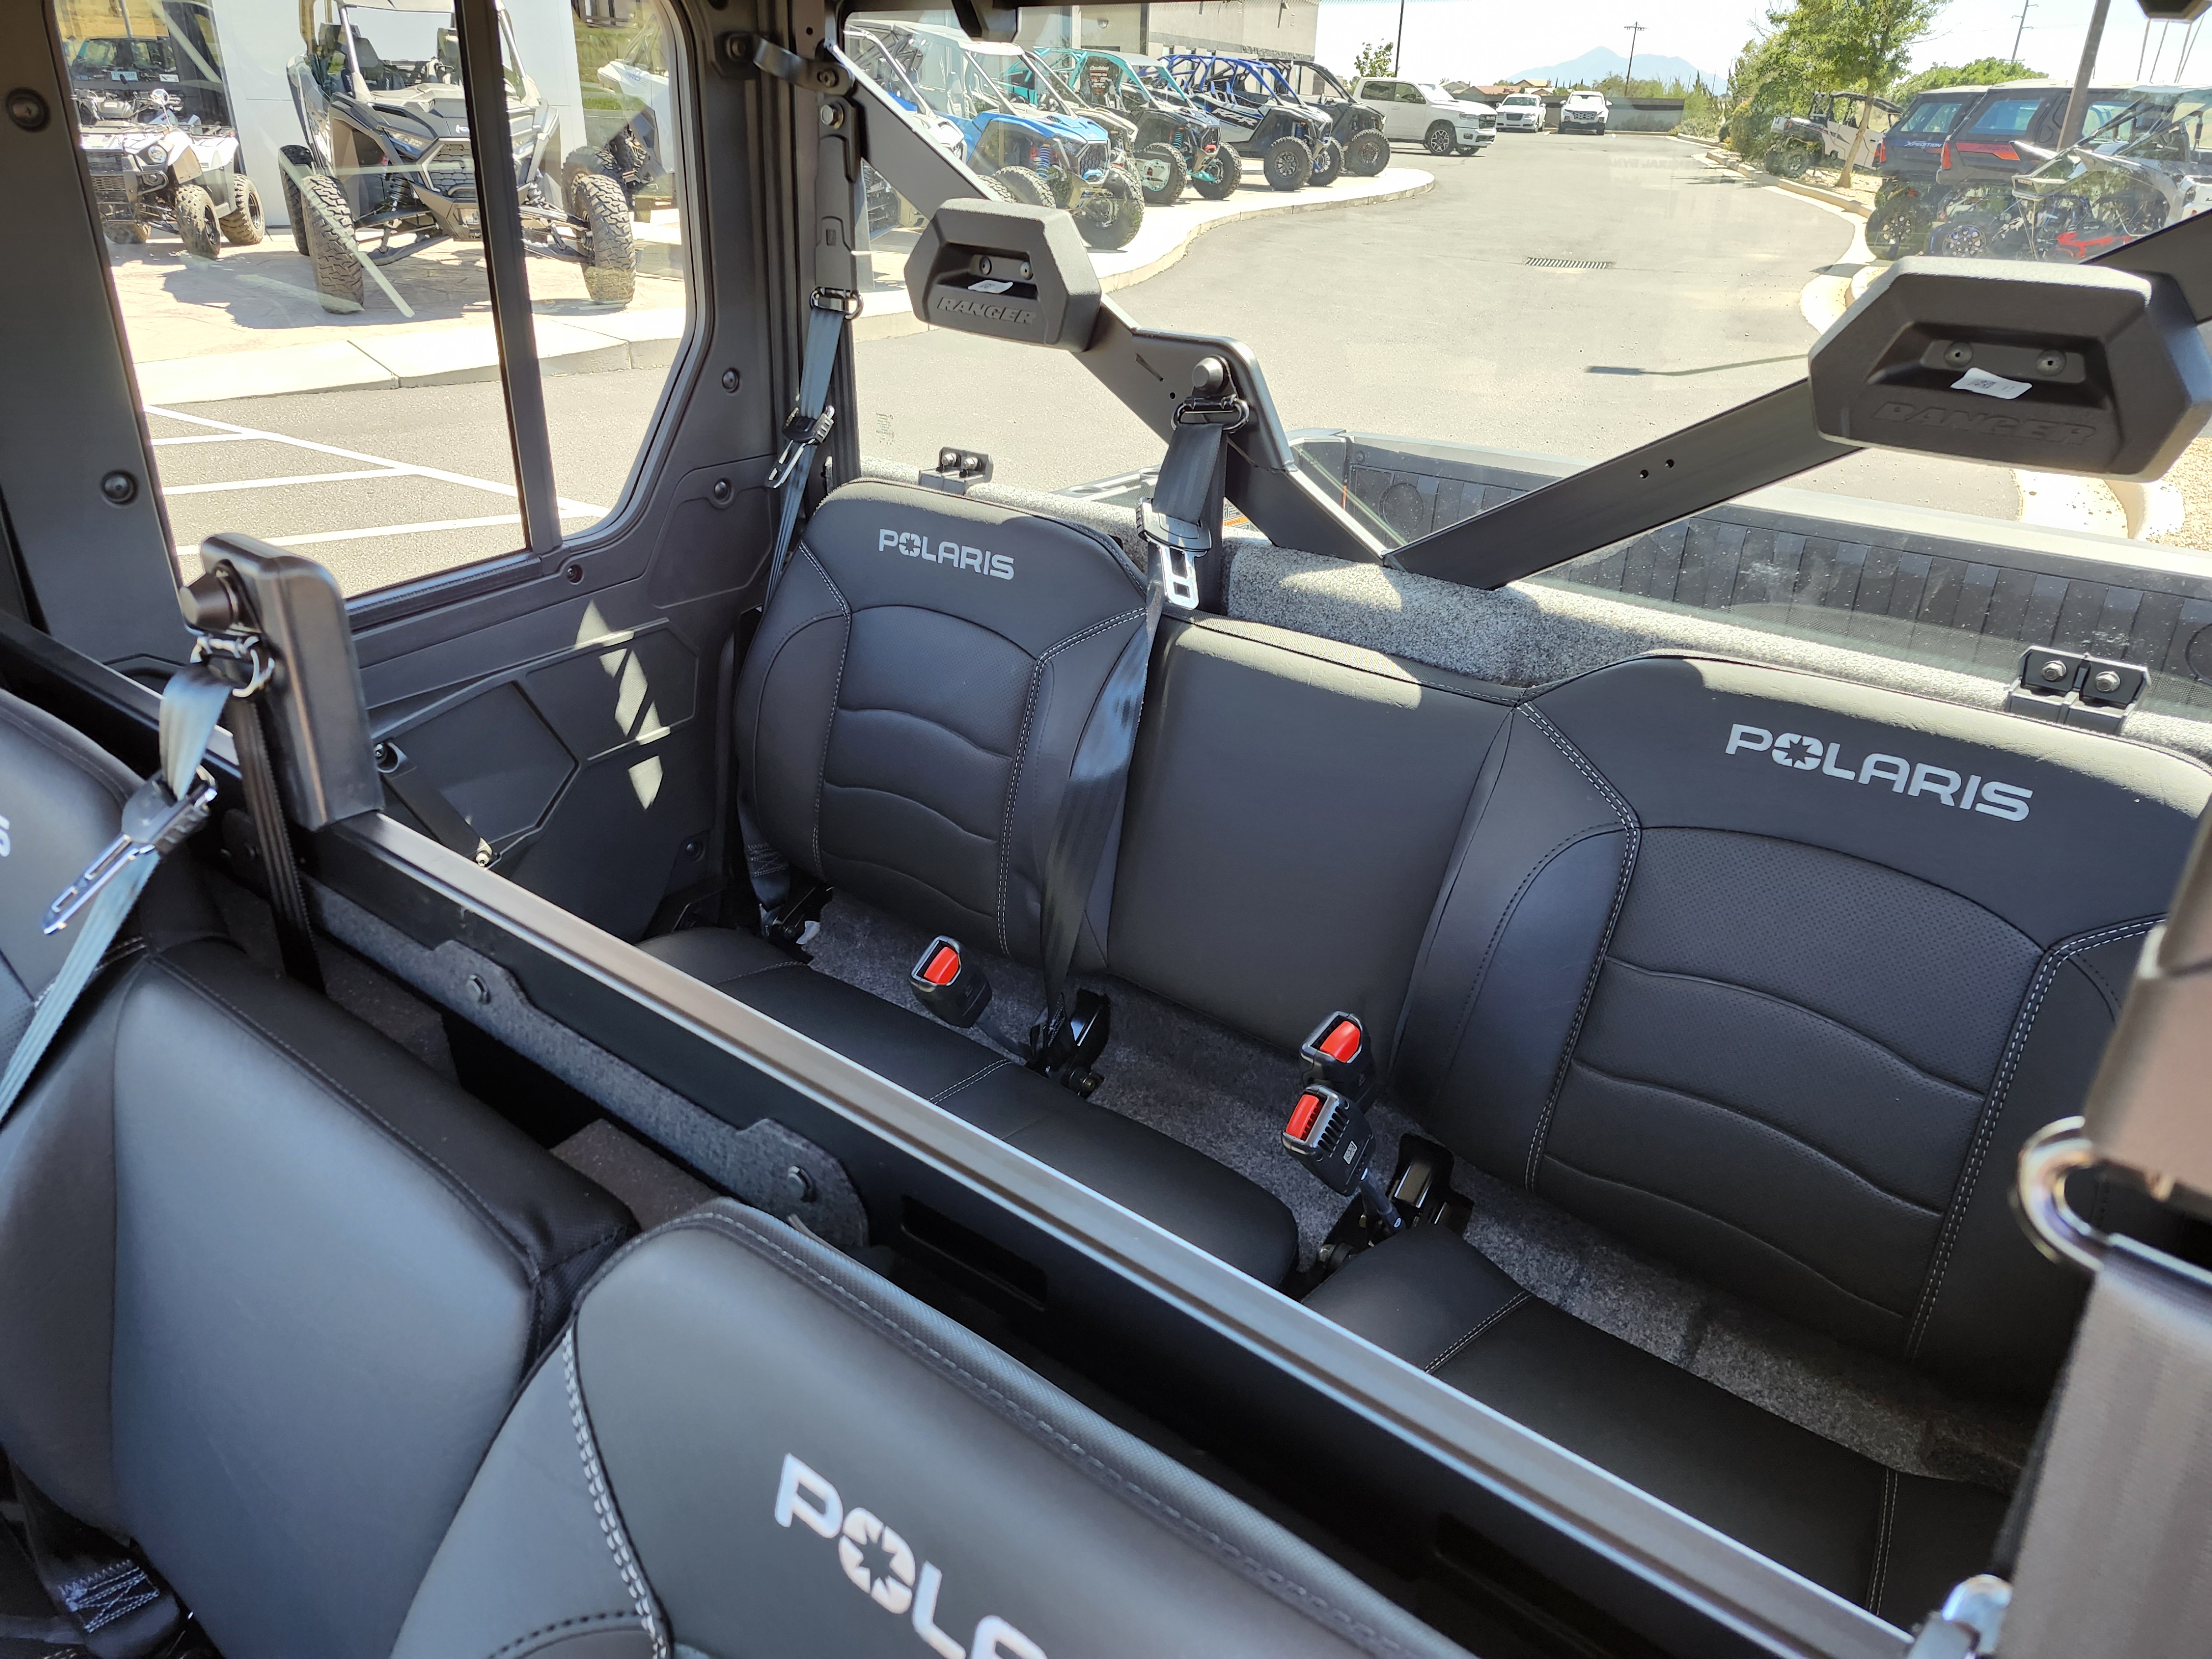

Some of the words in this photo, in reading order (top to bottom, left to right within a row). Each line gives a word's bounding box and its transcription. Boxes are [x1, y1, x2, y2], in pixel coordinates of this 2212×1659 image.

[625, 72, 641, 81] PRO
[1211, 107, 1258, 127] RZR
[937, 296, 1036, 325] RANGER
[1871, 401, 2097, 445] RANGER
[878, 528, 1015, 580] POLARIS
[1725, 723, 2033, 822] POLARIS
